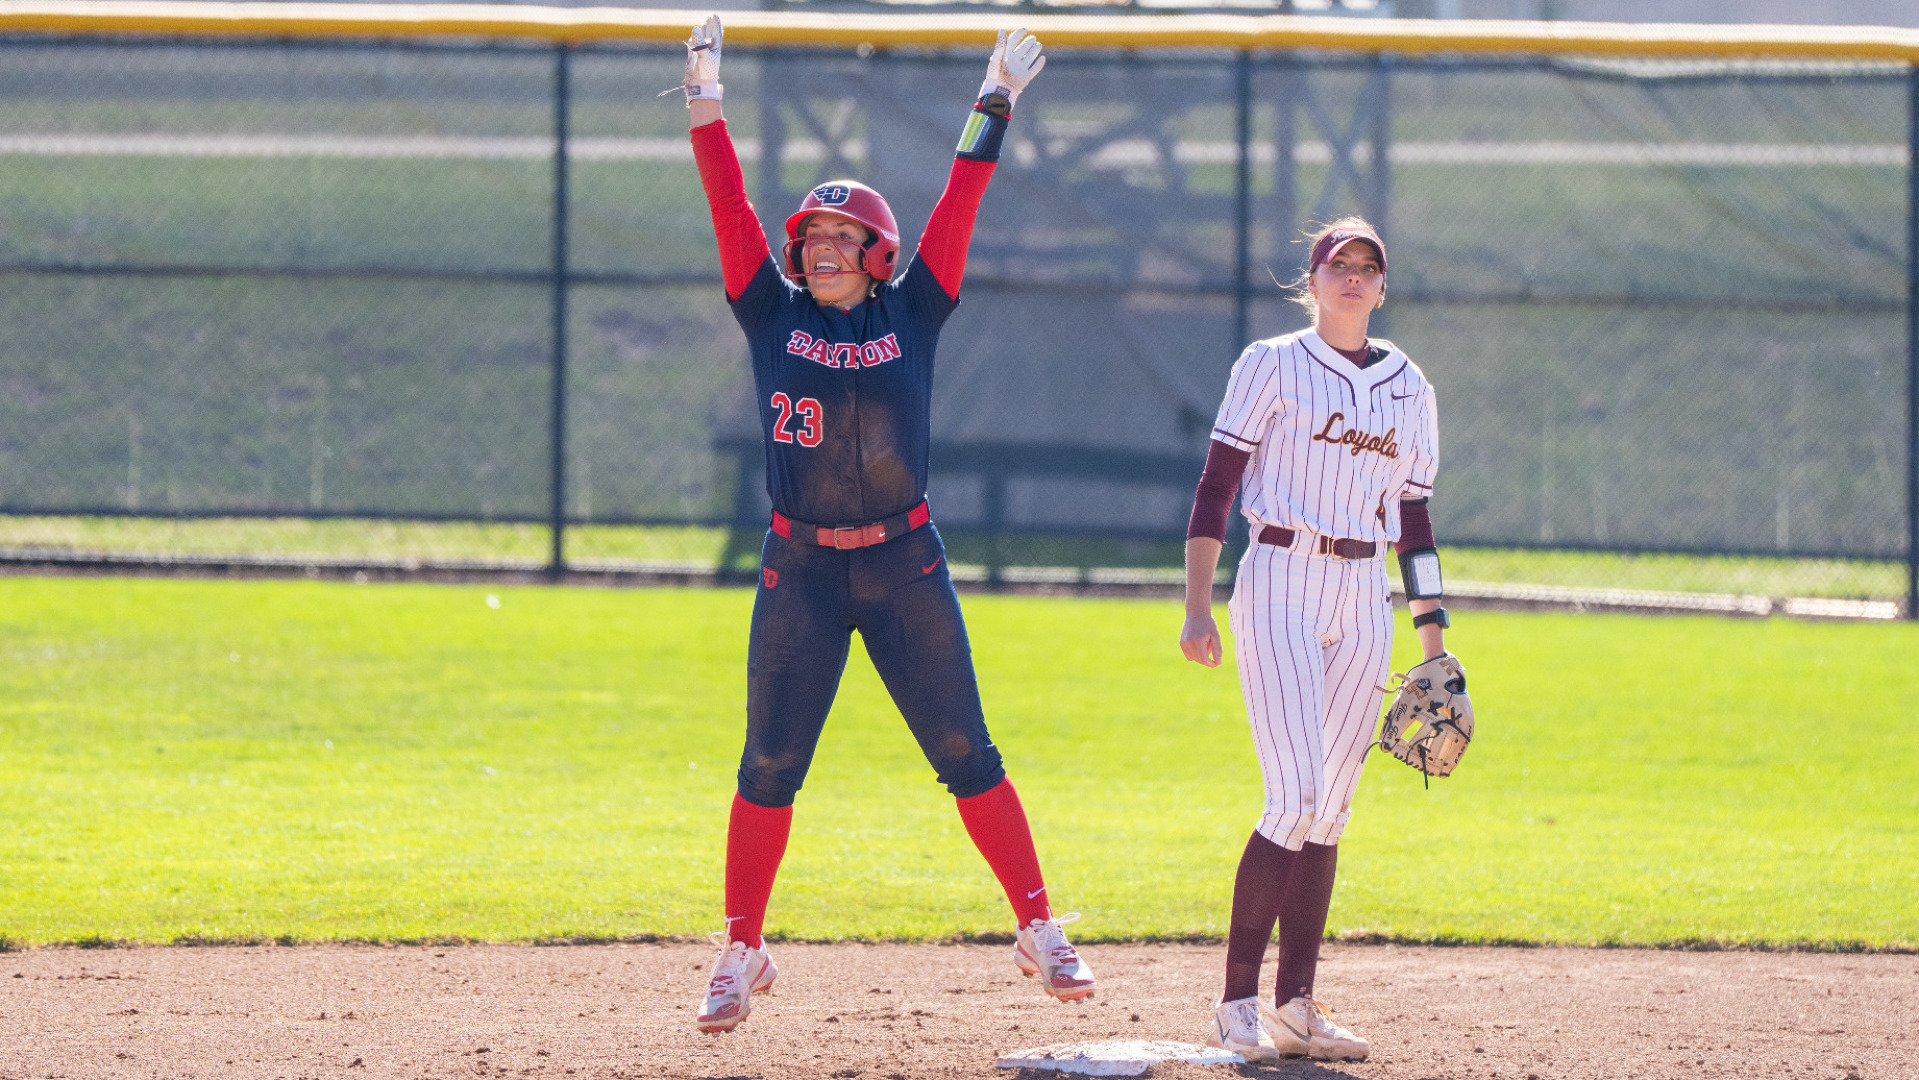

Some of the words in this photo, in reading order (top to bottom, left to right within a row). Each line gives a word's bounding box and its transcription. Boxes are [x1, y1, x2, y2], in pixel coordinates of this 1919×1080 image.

[787, 330, 902, 369] DAYTON
[771, 392, 823, 447] 23
[1313, 412, 1398, 459] Loyola
